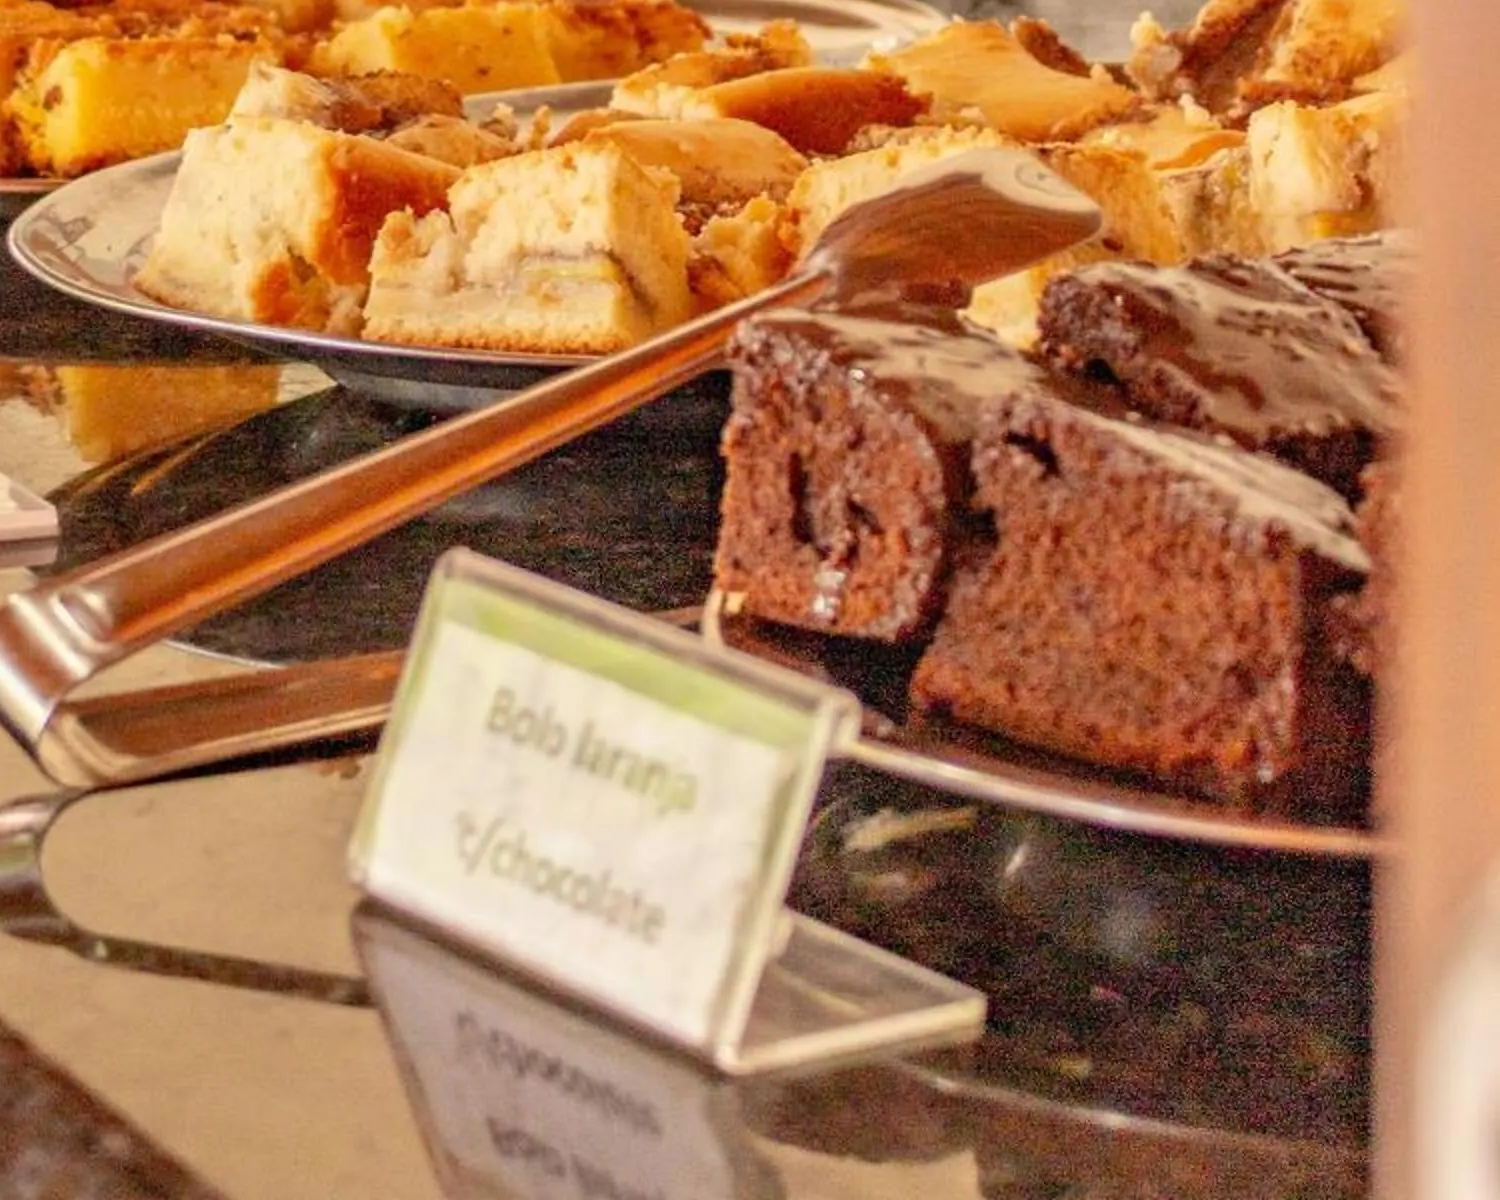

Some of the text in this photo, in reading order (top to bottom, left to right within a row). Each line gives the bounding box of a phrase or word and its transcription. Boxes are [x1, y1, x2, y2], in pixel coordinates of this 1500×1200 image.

[485, 684, 698, 816] Bolo laranja
[454, 810, 666, 944] c/chocolate
